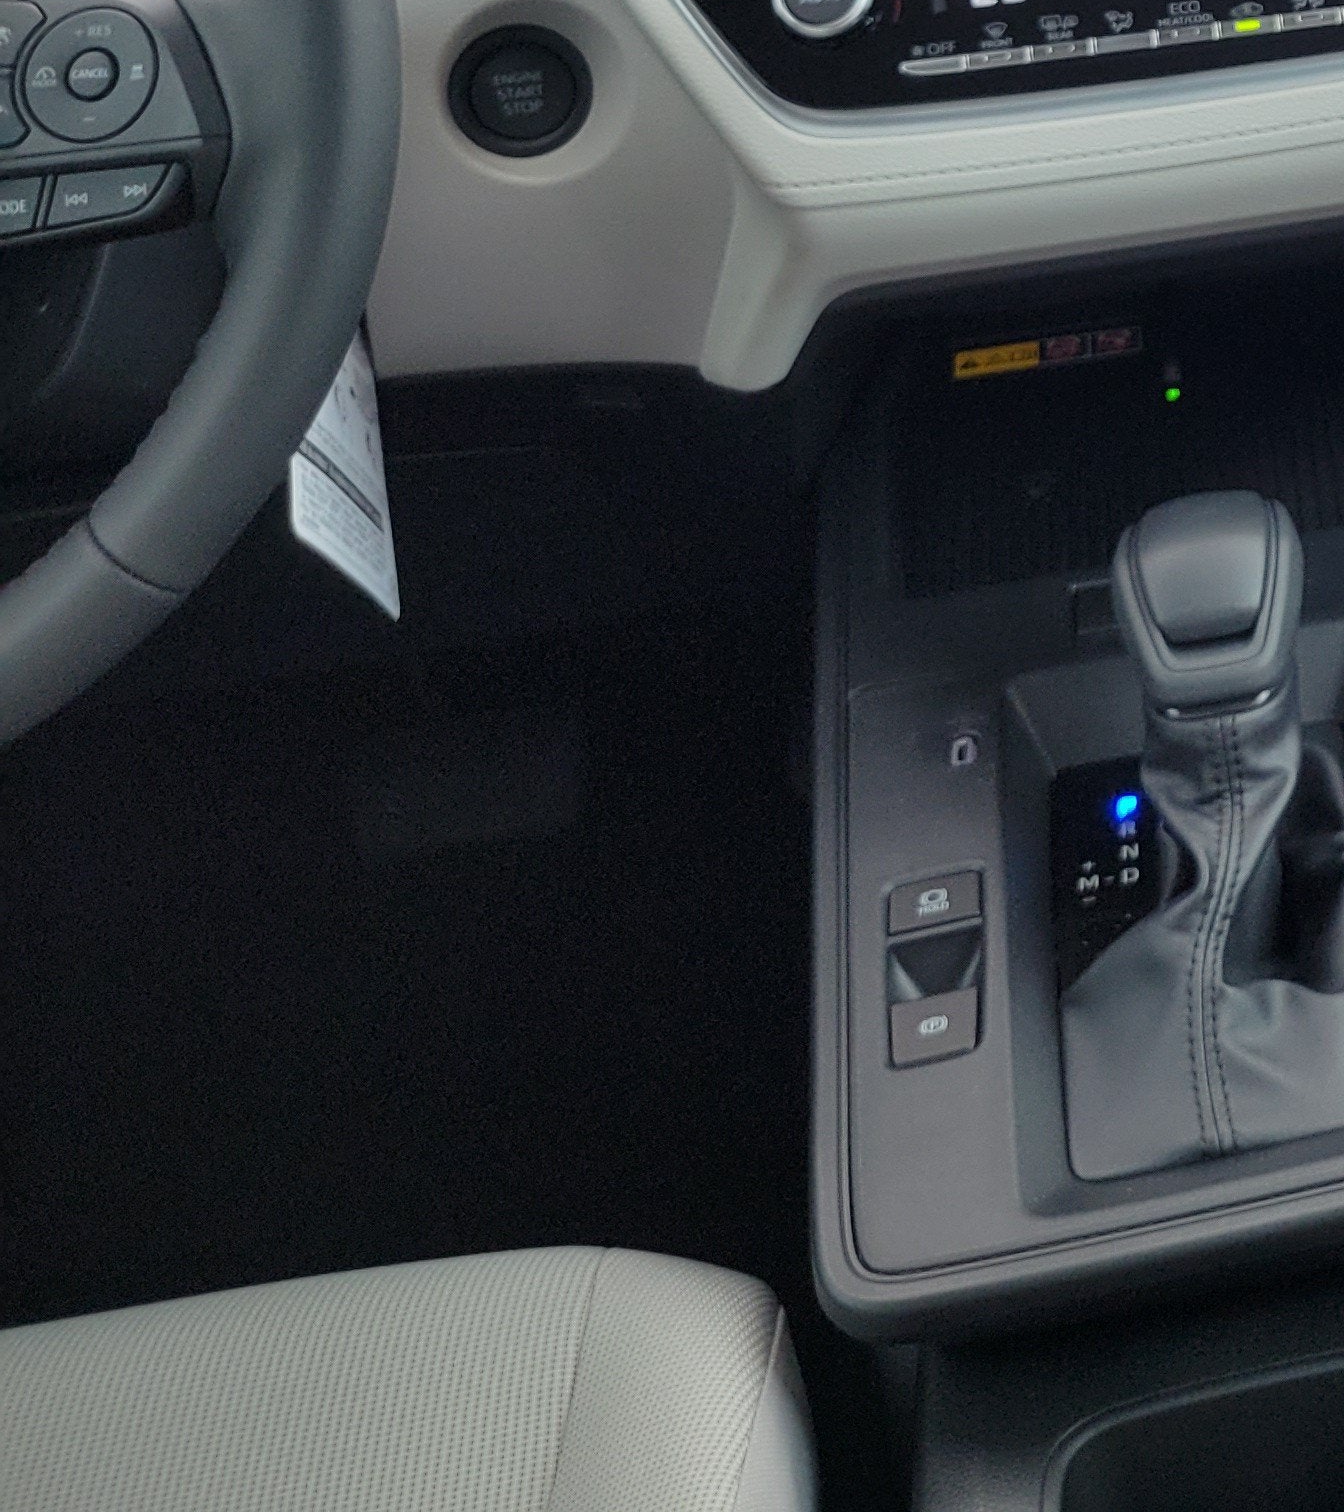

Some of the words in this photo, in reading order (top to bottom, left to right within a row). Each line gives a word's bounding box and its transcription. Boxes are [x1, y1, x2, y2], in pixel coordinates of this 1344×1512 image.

[1167, 0, 1201, 16] ECO
[1157, 12, 1215, 28] HEAT/COOL
[71, 67, 109, 79] CANCEL
[1119, 842, 1140, 861] N
[1076, 873, 1100, 893] M
[1120, 866, 1140, 885] D
